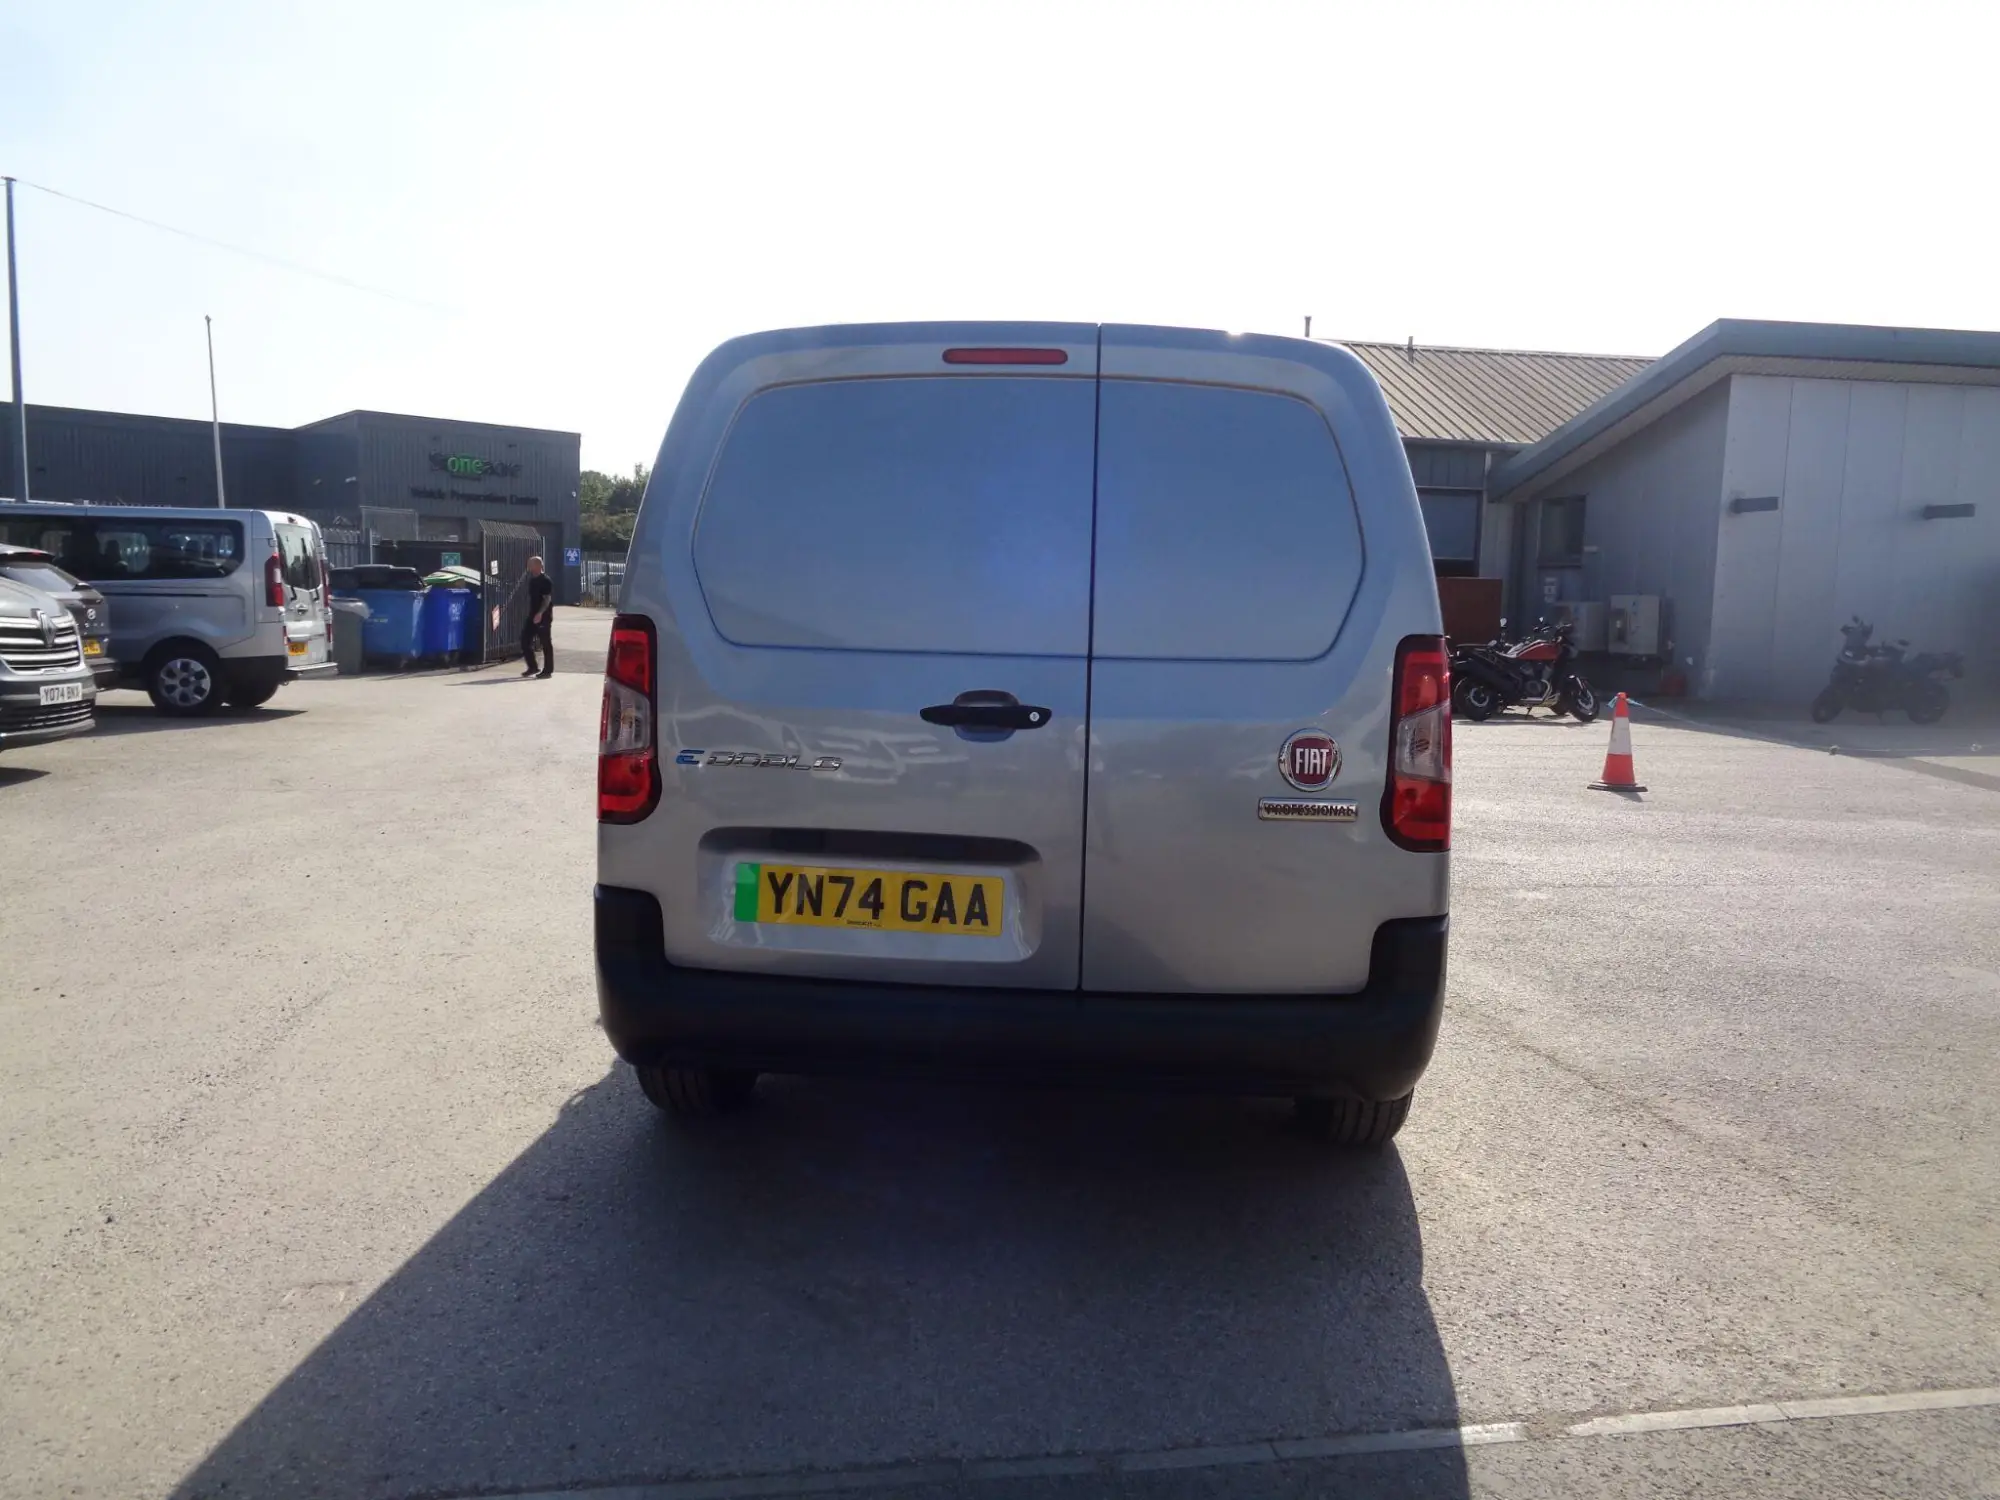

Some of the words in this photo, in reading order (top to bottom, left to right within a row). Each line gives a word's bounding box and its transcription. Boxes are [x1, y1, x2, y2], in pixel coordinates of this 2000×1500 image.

[1295, 748, 1329, 775] FIAT
[766, 871, 885, 920] YN74
[900, 879, 989, 927] GAA
